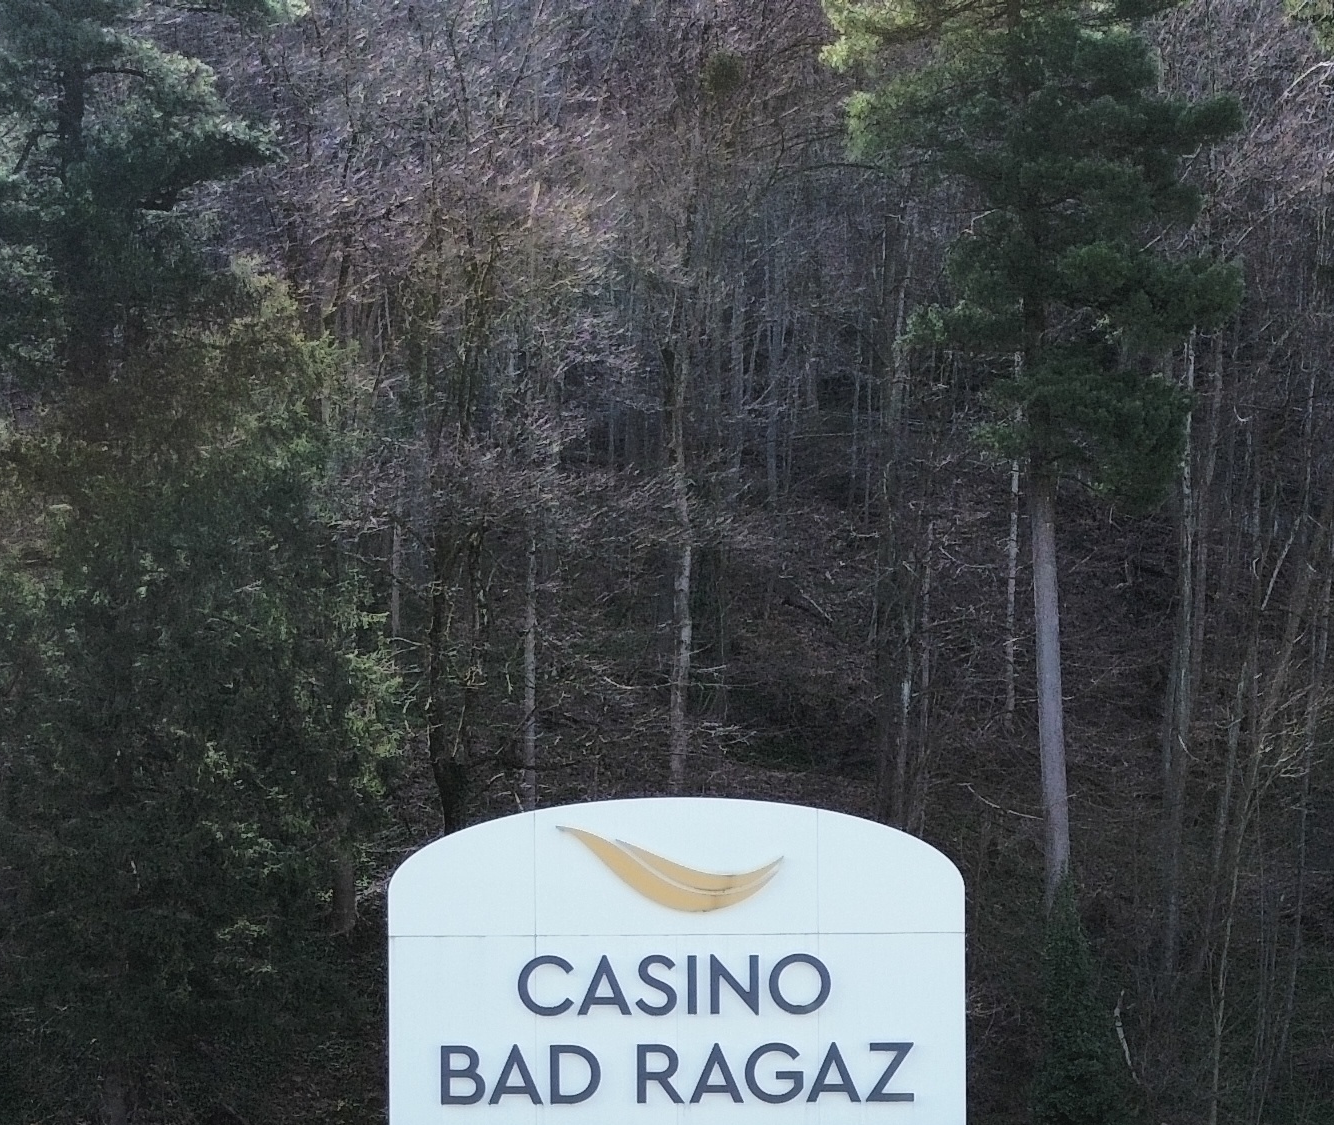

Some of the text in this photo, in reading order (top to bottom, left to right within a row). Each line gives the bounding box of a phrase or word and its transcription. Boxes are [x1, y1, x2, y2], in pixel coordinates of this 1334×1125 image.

[518, 954, 831, 1016] CASINO
[441, 1042, 915, 1106] BAD RAGAZ
